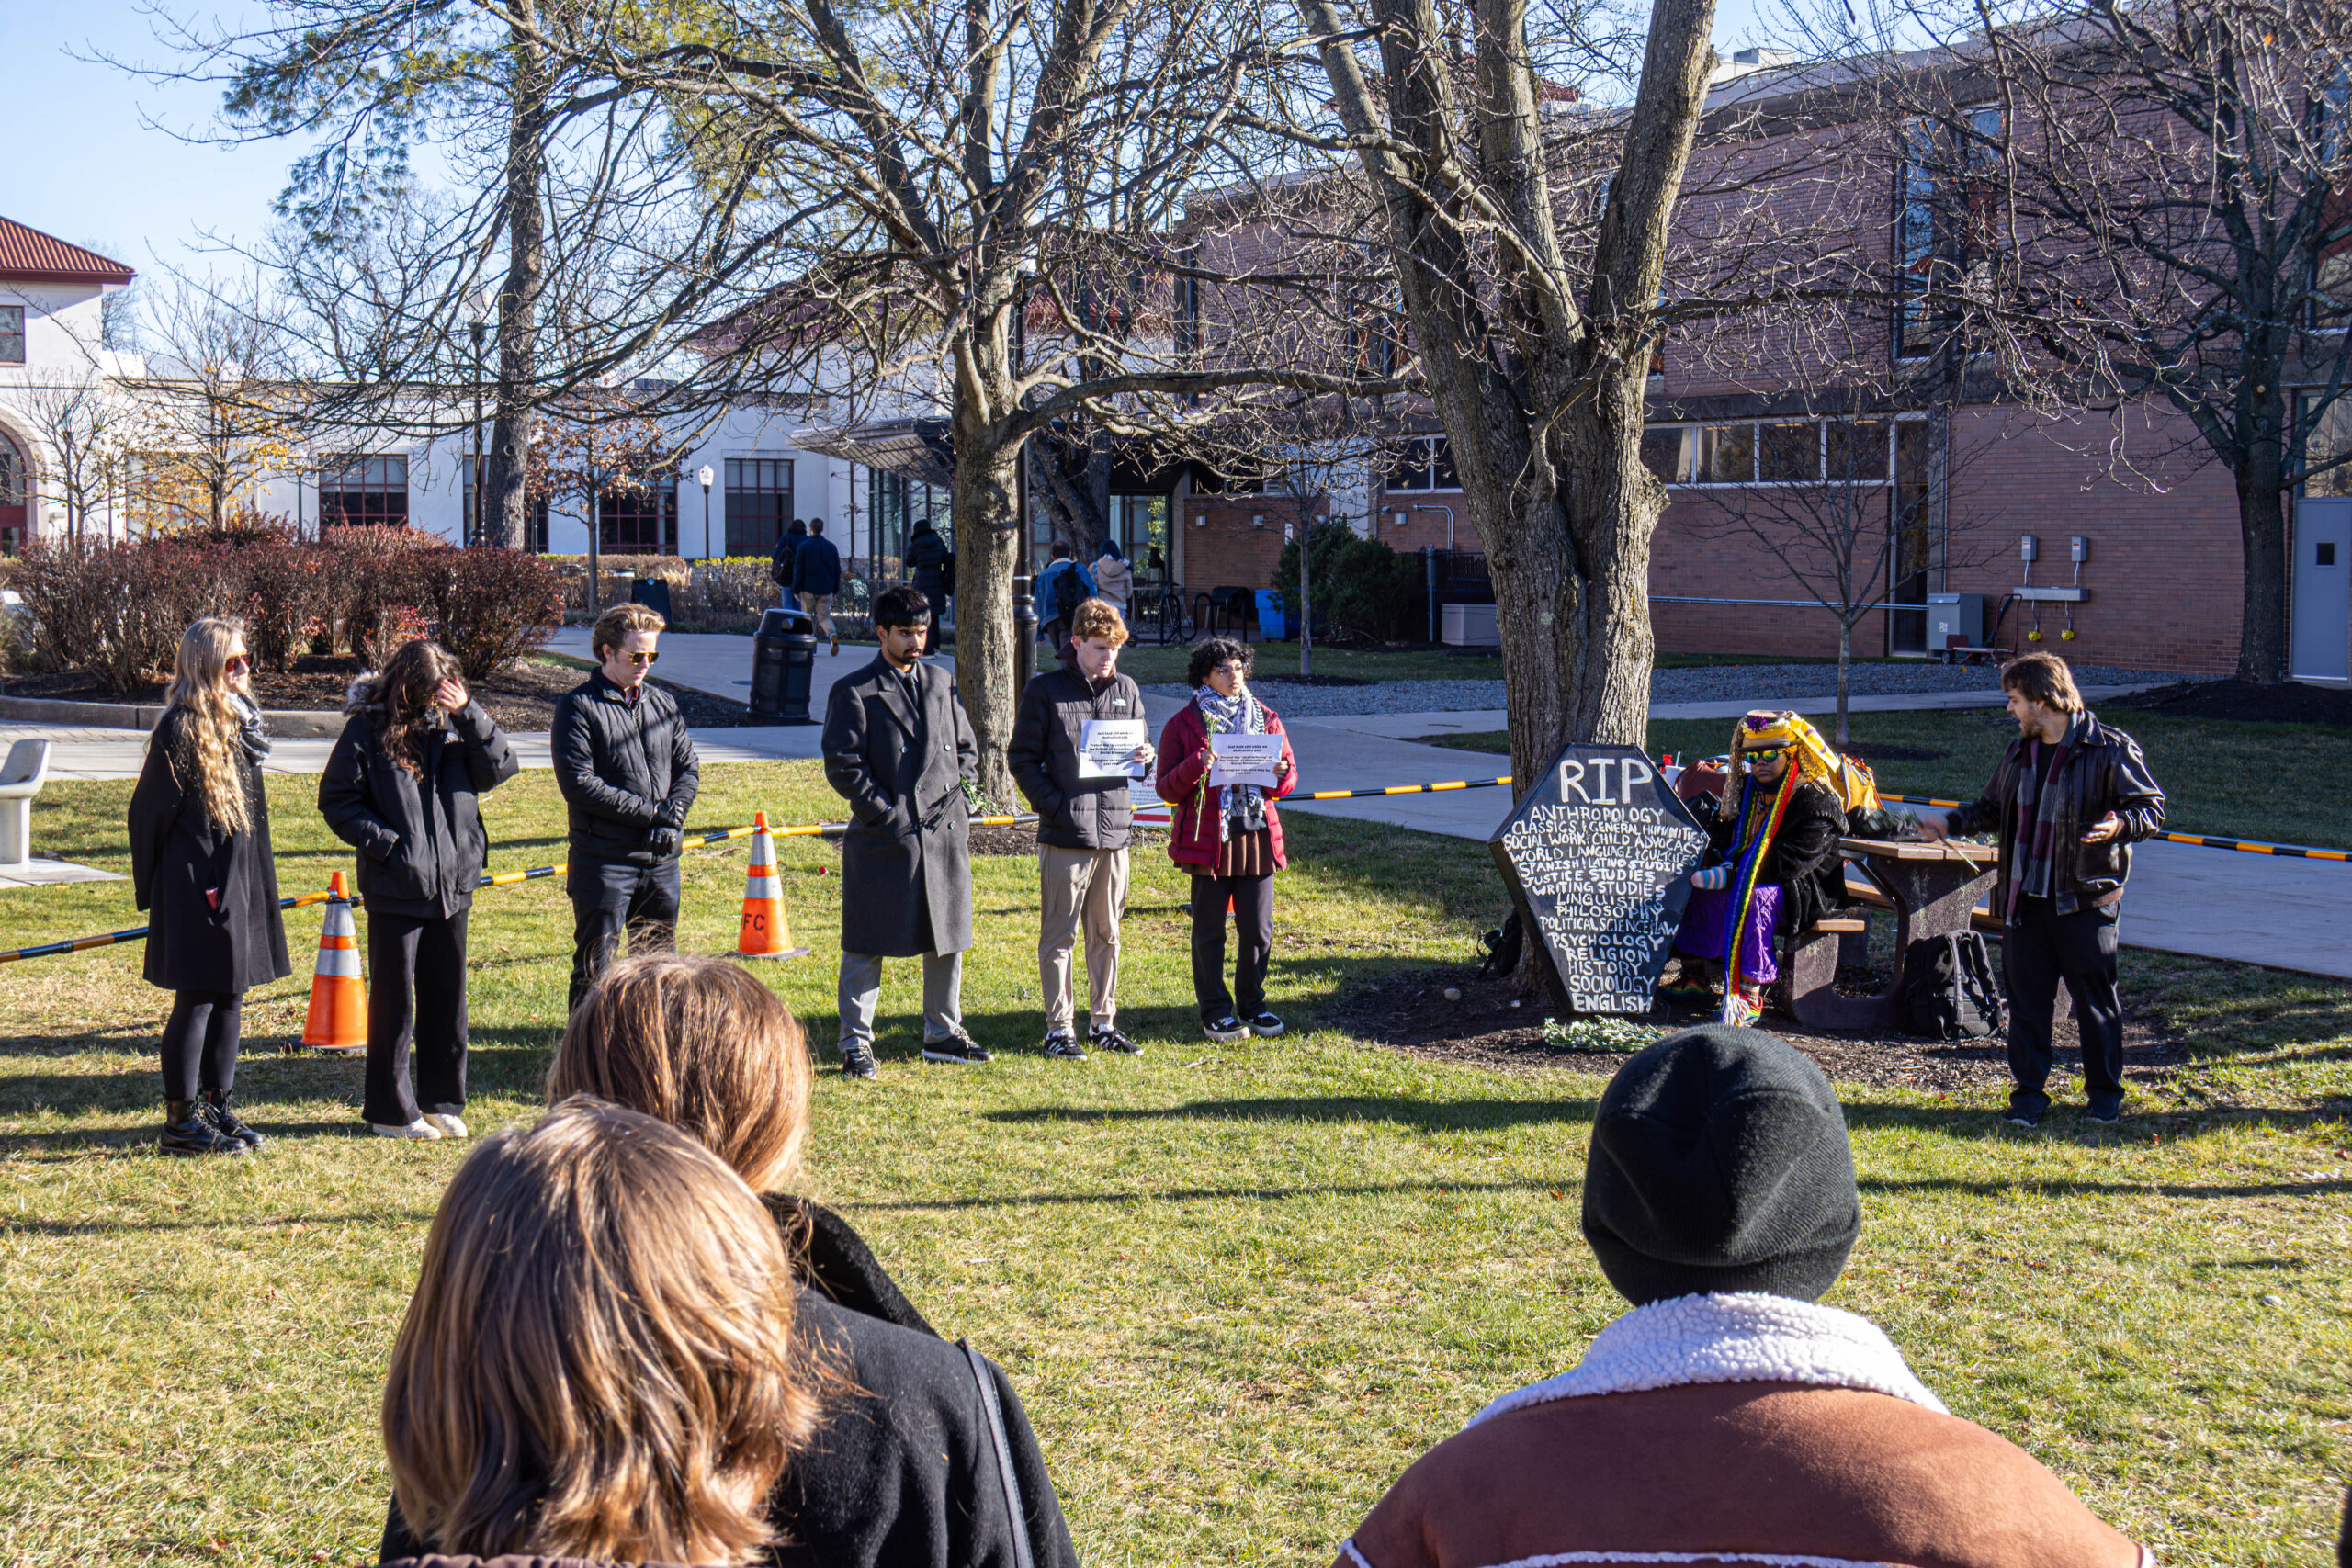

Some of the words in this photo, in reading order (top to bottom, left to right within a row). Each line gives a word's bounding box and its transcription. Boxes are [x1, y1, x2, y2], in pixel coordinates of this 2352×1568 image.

[1559, 758, 1653, 805] RIP
[1530, 805, 1663, 824] ANTHROPOLOGY
[1511, 820, 1577, 835] CLASSICS
[1589, 820, 1640, 836] GENERAL
[1643, 824, 1707, 844] HUMANITIES
[1502, 833, 1547, 852] SOCIAL
[1548, 831, 1586, 846] WORK
[1592, 832, 1630, 845] CHILD
[1634, 833, 1704, 855] ADVOCACY
[1508, 847, 1563, 863] WORLD
[1568, 844, 1634, 859] LANGUAGE
[1519, 859, 1579, 878] SPANISH
[1588, 856, 1627, 869] LATINO
[1522, 869, 1585, 888] JUSTICE
[1589, 868, 1656, 883] STUDIES
[1532, 881, 1594, 897] WRITING
[1597, 881, 1666, 898] STUDIES
[1556, 892, 1663, 909] LINGUISTICS
[741, 912, 765, 931] FC
[1554, 905, 1665, 921] PHILOSOPHY
[1539, 916, 1599, 931] POLITICAL
[1599, 917, 1649, 933] SCIENCE
[1655, 921, 1679, 935] LAW
[1547, 931, 1665, 952] PSYCHOLOGY
[1566, 946, 1651, 963] RELIGION
[1568, 960, 1642, 976] HISTORY
[1569, 974, 1655, 995] SOCIOLOGY
[1571, 992, 1654, 1014] ENGLISH
